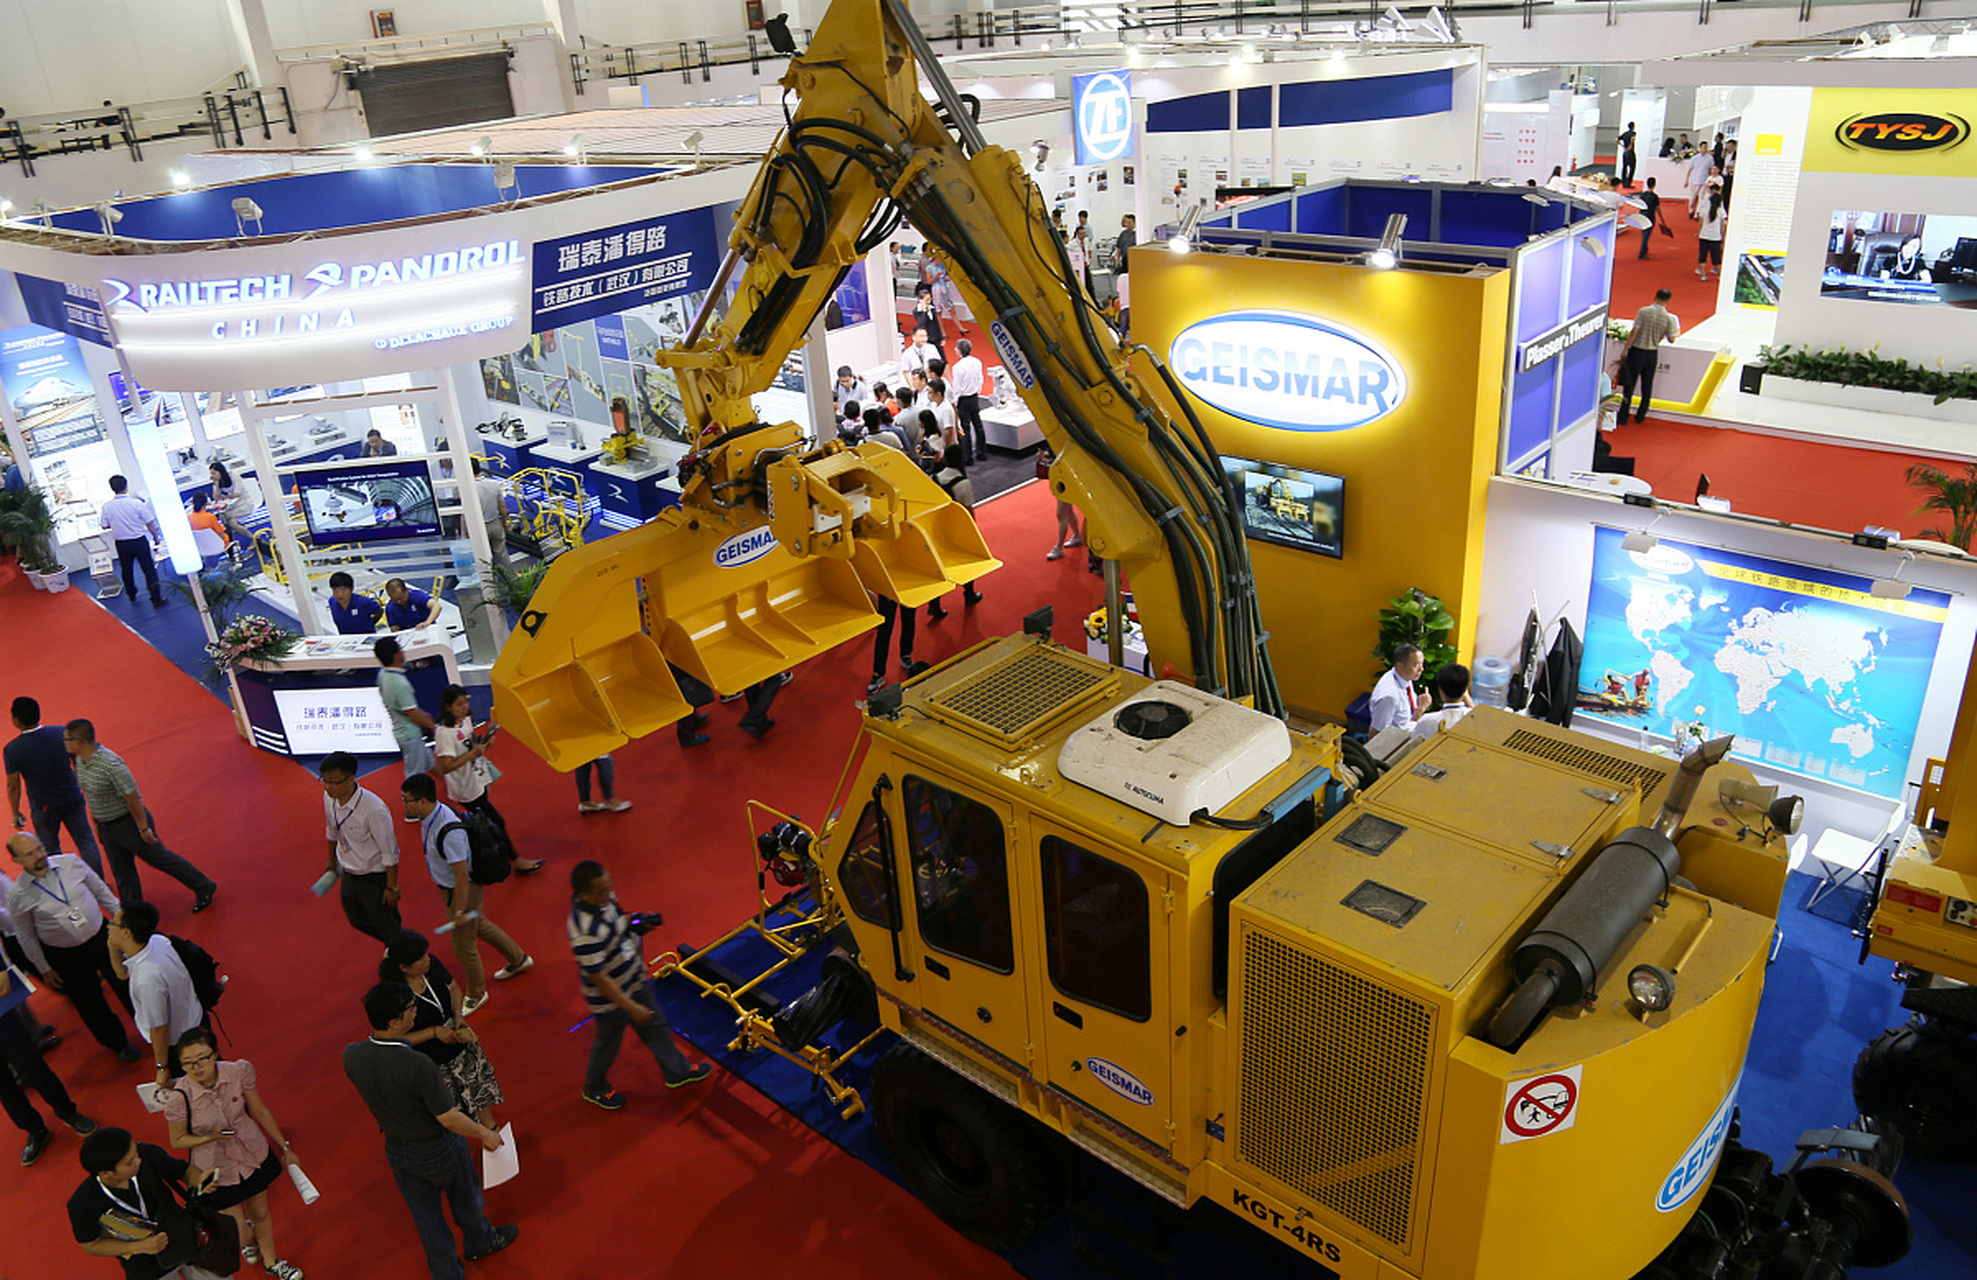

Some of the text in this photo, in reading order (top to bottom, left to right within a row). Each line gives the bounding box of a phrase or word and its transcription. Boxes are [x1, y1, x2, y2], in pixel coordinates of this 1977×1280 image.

[1083, 90, 1126, 144] ZF
[1849, 122, 1955, 141] TYSJ
[138, 274, 293, 308] RAILTECH
[350, 239, 527, 290] PANDROL
[557, 225, 667, 273] 瑞泰潘得路
[210, 308, 356, 340] CHINA
[389, 315, 515, 350] DELACHAUX GROUP
[1525, 334, 1566, 370] Plasser
[1568, 312, 1606, 345] Theurer
[991, 322, 1035, 389] GEISMAR
[1176, 337, 1390, 414] GEISMAR
[716, 531, 778, 563] GEISMA
[1087, 1059, 1152, 1104] GEISMAR
[1233, 1187, 1341, 1263] KGT-4RS
